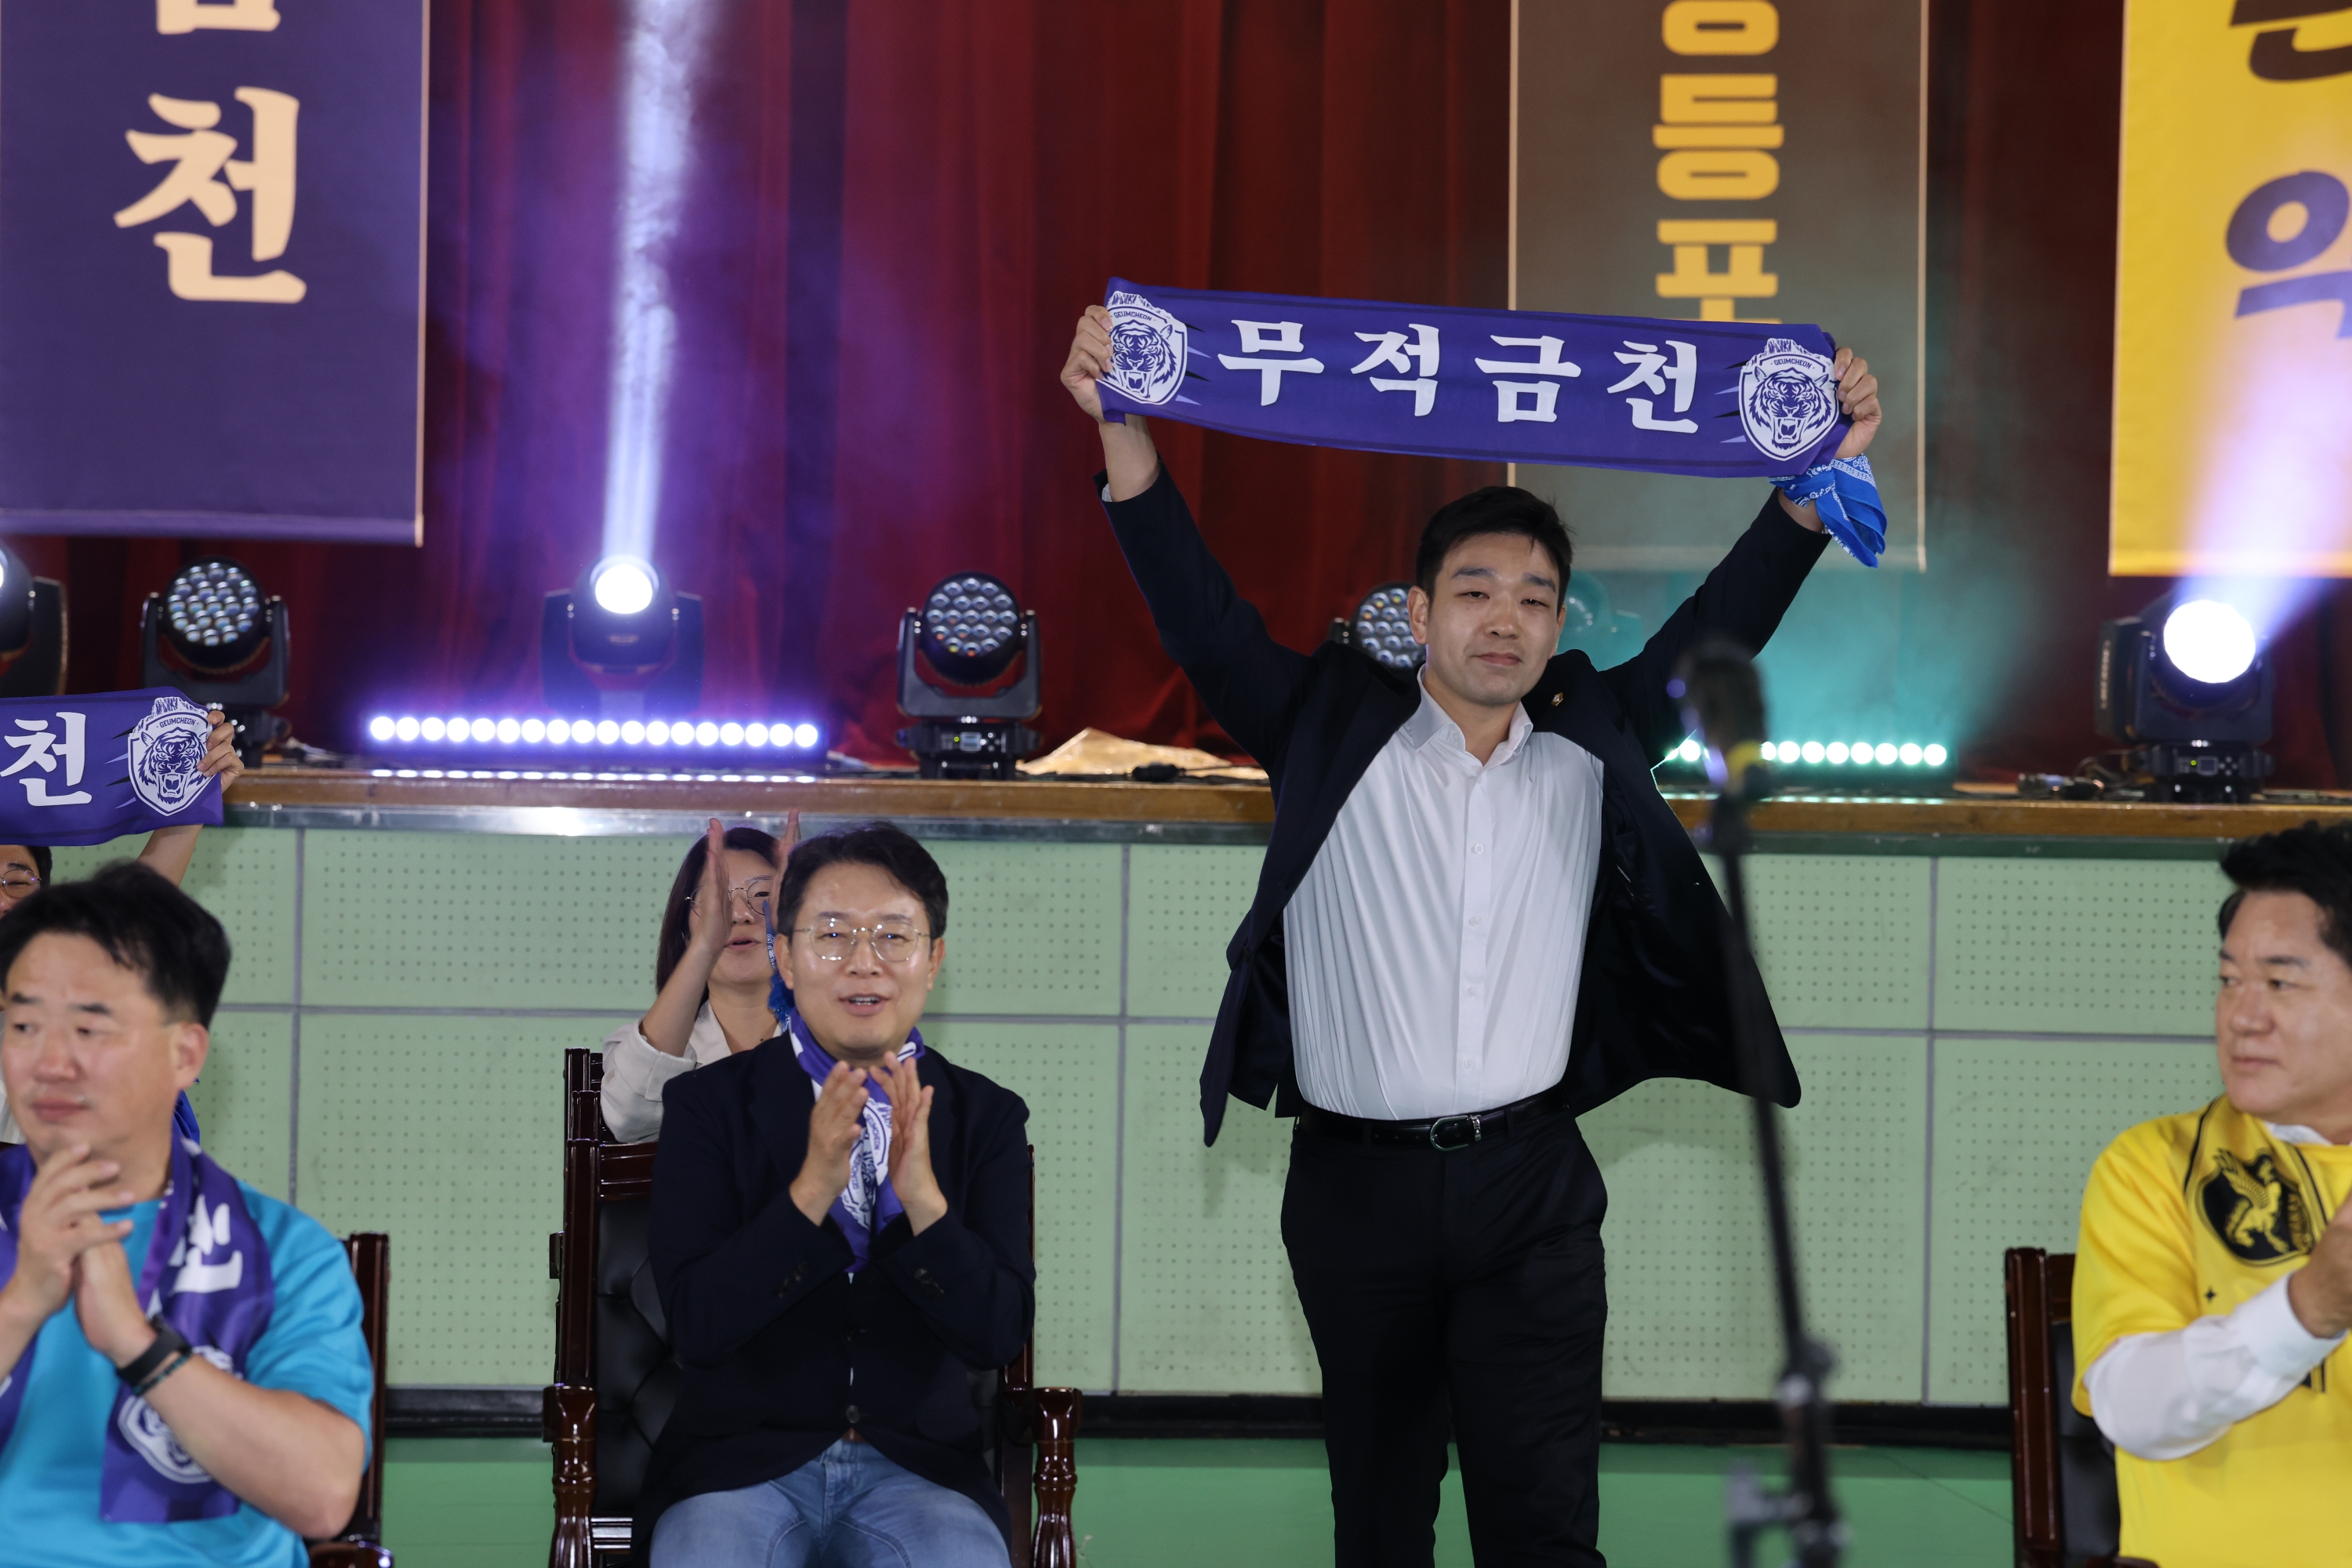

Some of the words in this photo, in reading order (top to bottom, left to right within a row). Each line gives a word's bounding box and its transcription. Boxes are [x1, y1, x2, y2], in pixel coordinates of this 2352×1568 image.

[1113, 311, 1152, 321] GEUMCHEON
[1773, 358, 1812, 368] GEUMCHEON
[159, 717, 196, 728] GEUMCHEON
[0, 711, 93, 806] 천
